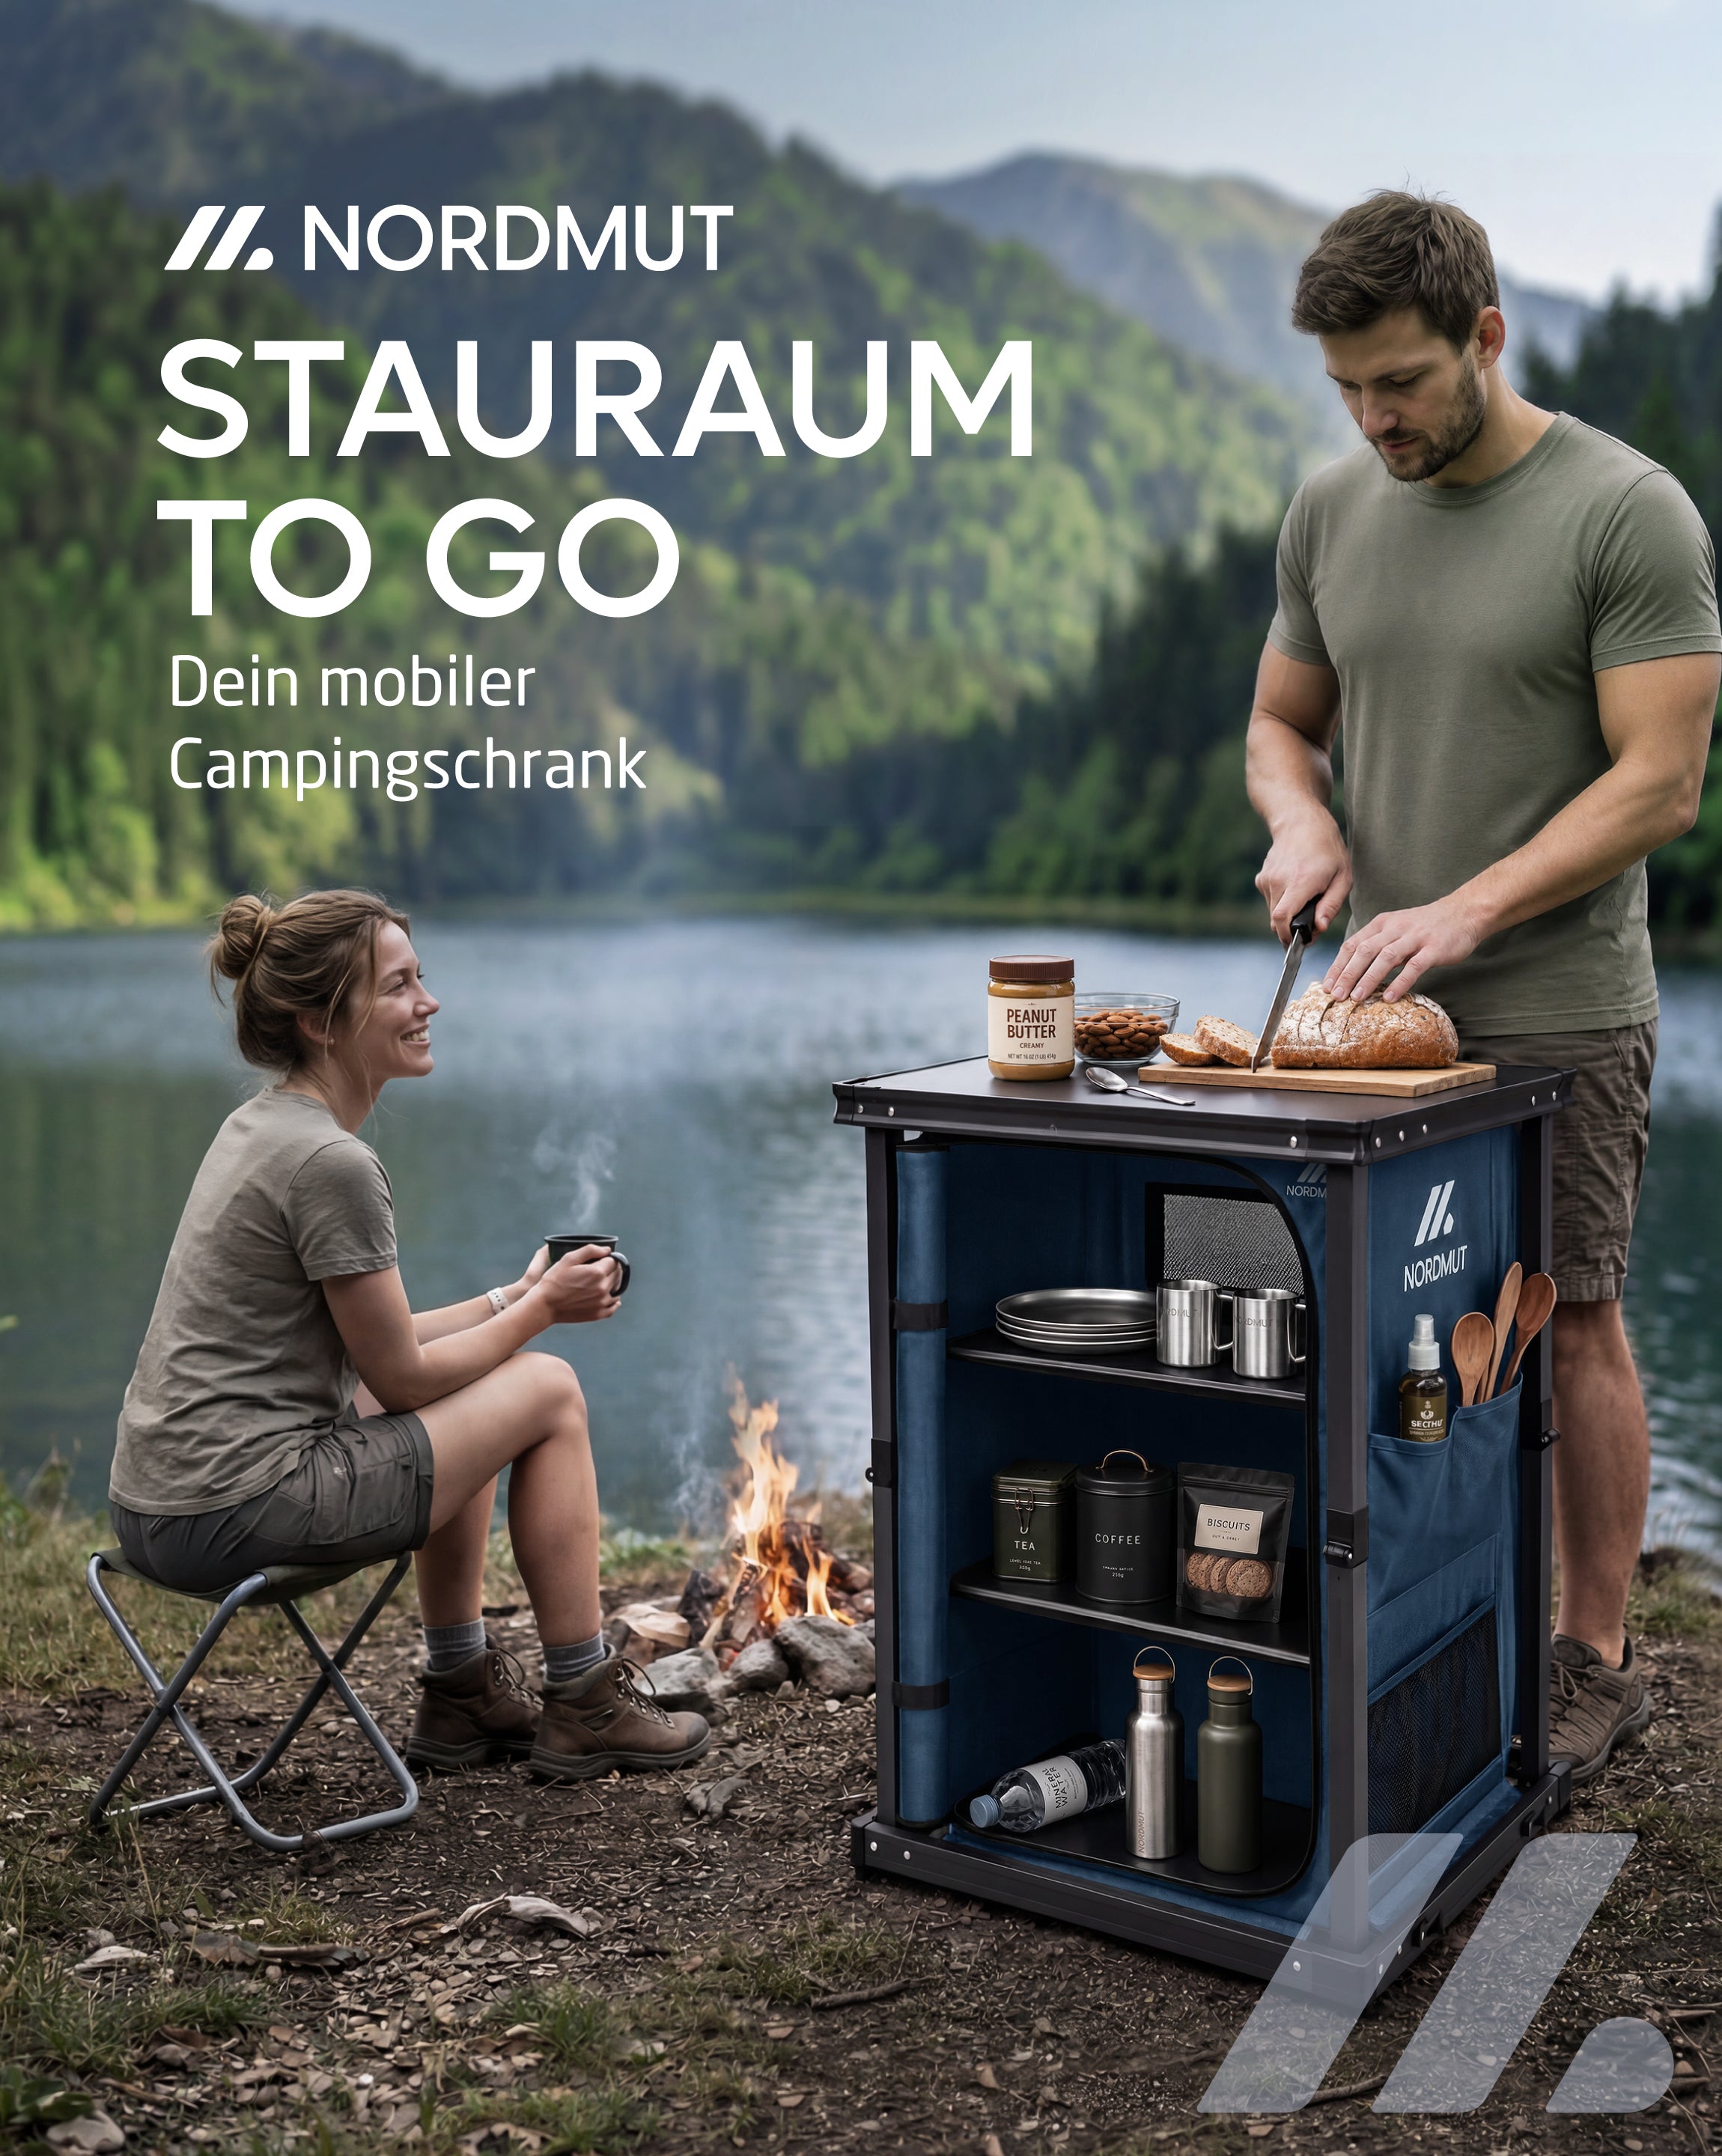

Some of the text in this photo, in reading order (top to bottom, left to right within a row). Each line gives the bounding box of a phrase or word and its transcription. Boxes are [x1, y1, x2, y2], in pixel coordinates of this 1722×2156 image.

[1007, 1008, 1056, 1023] PEANUT
[1008, 1024, 1056, 1038] BUTTER
[1286, 1185, 1327, 1198] NORDM
[1404, 1244, 1468, 1293] NORDMUT
[1207, 1518, 1250, 1532] BISCUITS
[1014, 1540, 1035, 1550] TEA
[1095, 1532, 1141, 1545] COFFEE
[1042, 1767, 1062, 1809] MINERAL
[1049, 1767, 1068, 1807] WATER
